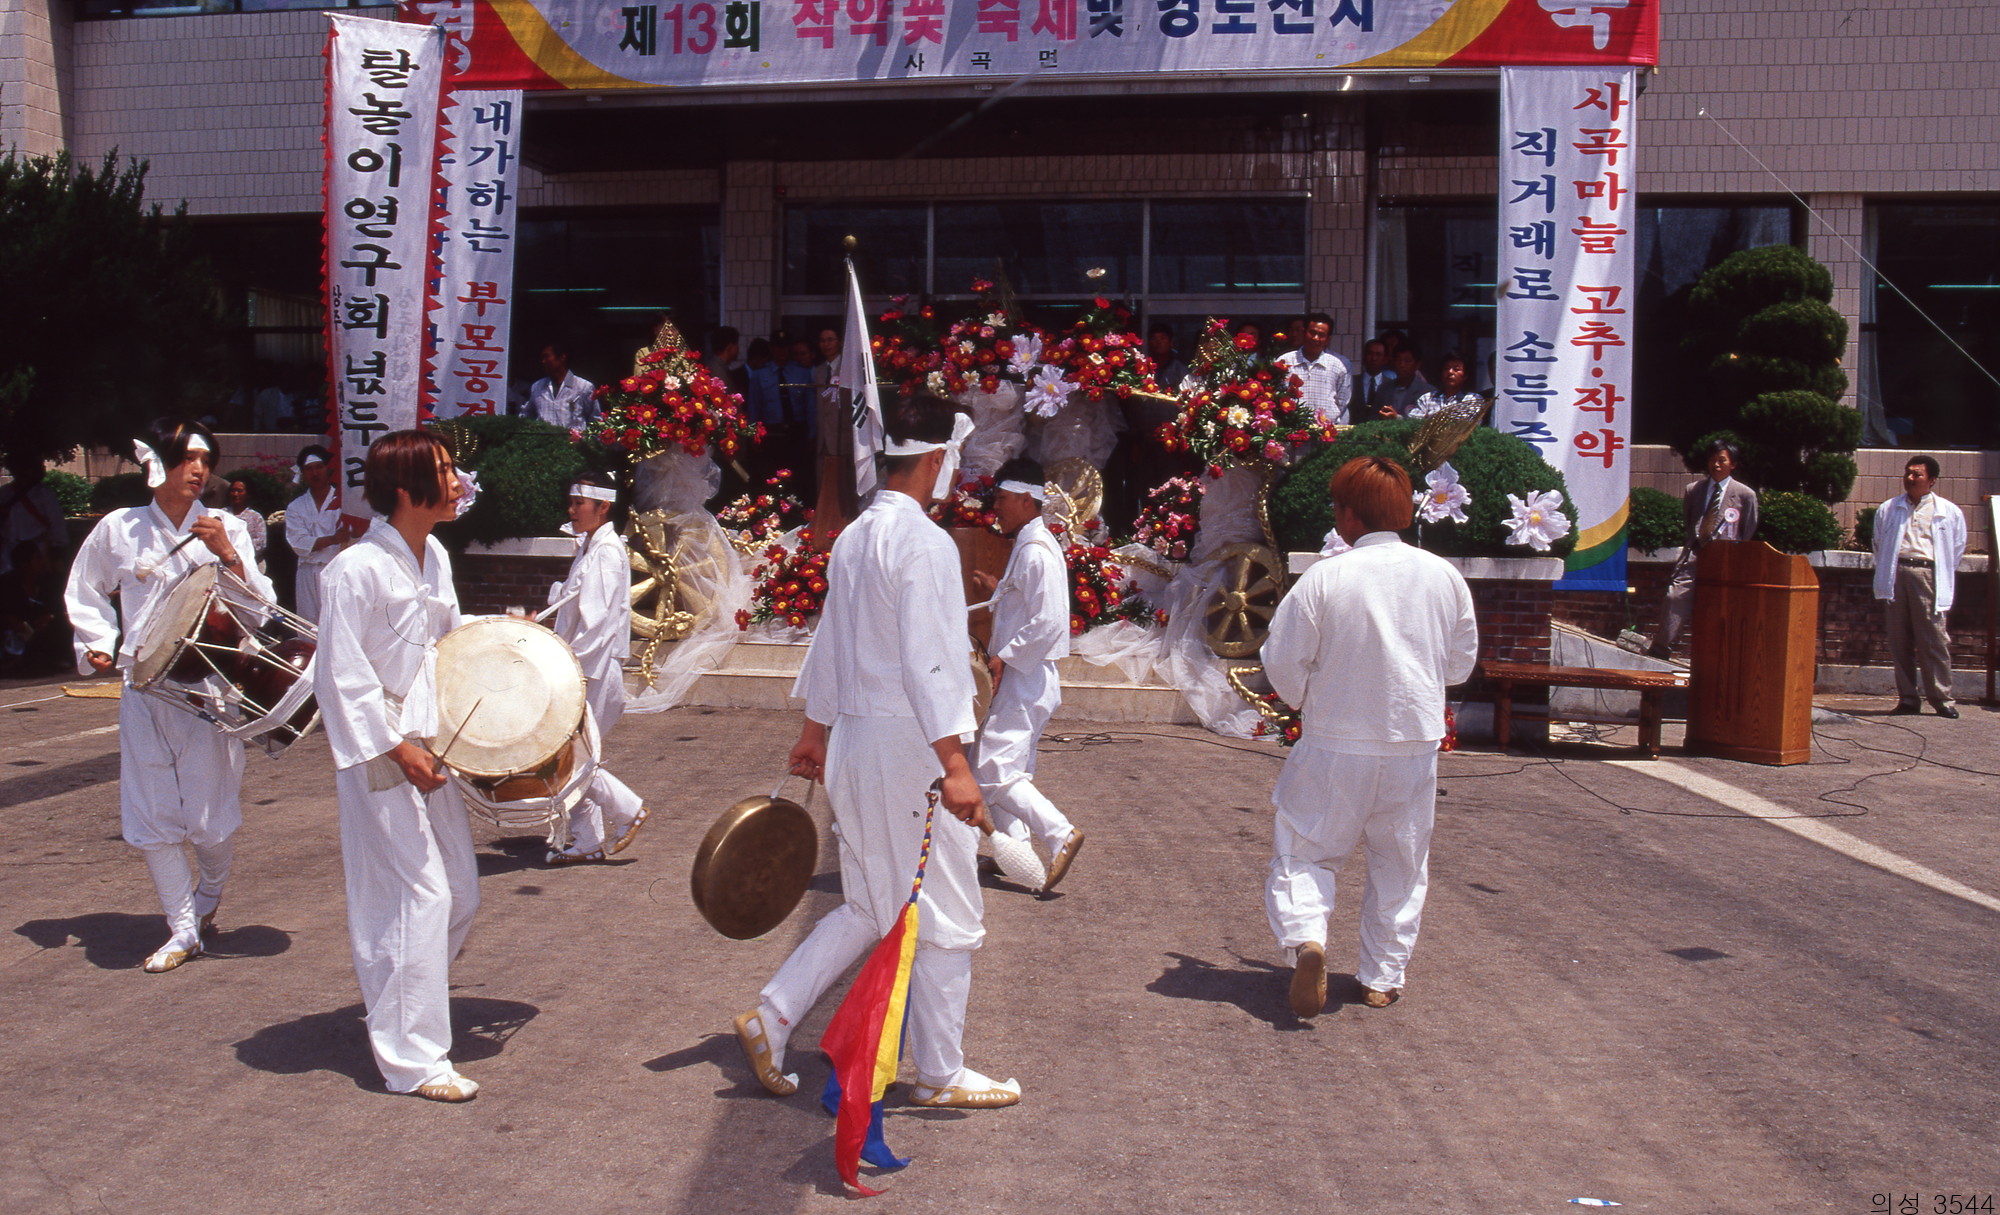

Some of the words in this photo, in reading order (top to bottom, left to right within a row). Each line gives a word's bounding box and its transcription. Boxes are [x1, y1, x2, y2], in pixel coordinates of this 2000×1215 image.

[618, 1, 760, 56] 제13회
[792, 0, 945, 49] 작약꽃
[461, 100, 515, 253] 내가하는
[1506, 127, 1560, 301] 직거래로
[1571, 82, 1629, 254] 사곡마늘
